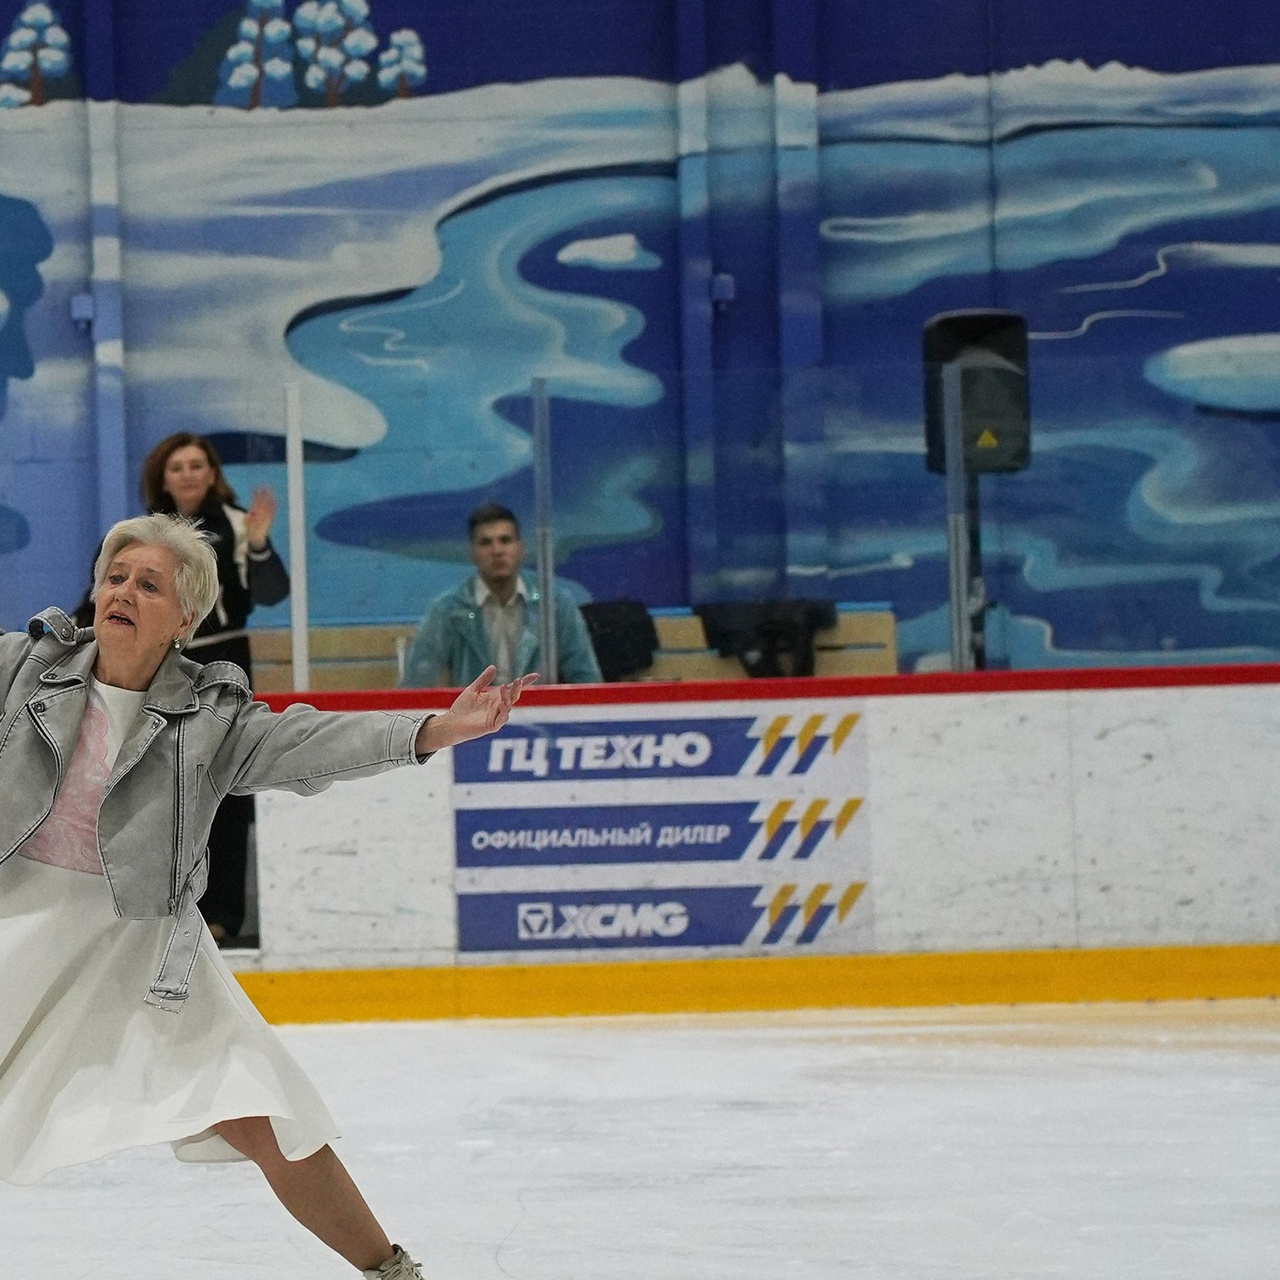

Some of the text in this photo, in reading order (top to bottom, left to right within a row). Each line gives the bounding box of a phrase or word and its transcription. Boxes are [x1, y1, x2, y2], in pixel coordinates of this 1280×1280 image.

[556, 730, 712, 770] ТЕХНО
[472, 821, 730, 851] ОФИЦИАЛЬНЫЙ ДИЛЕР
[553, 901, 690, 939] XCMG
